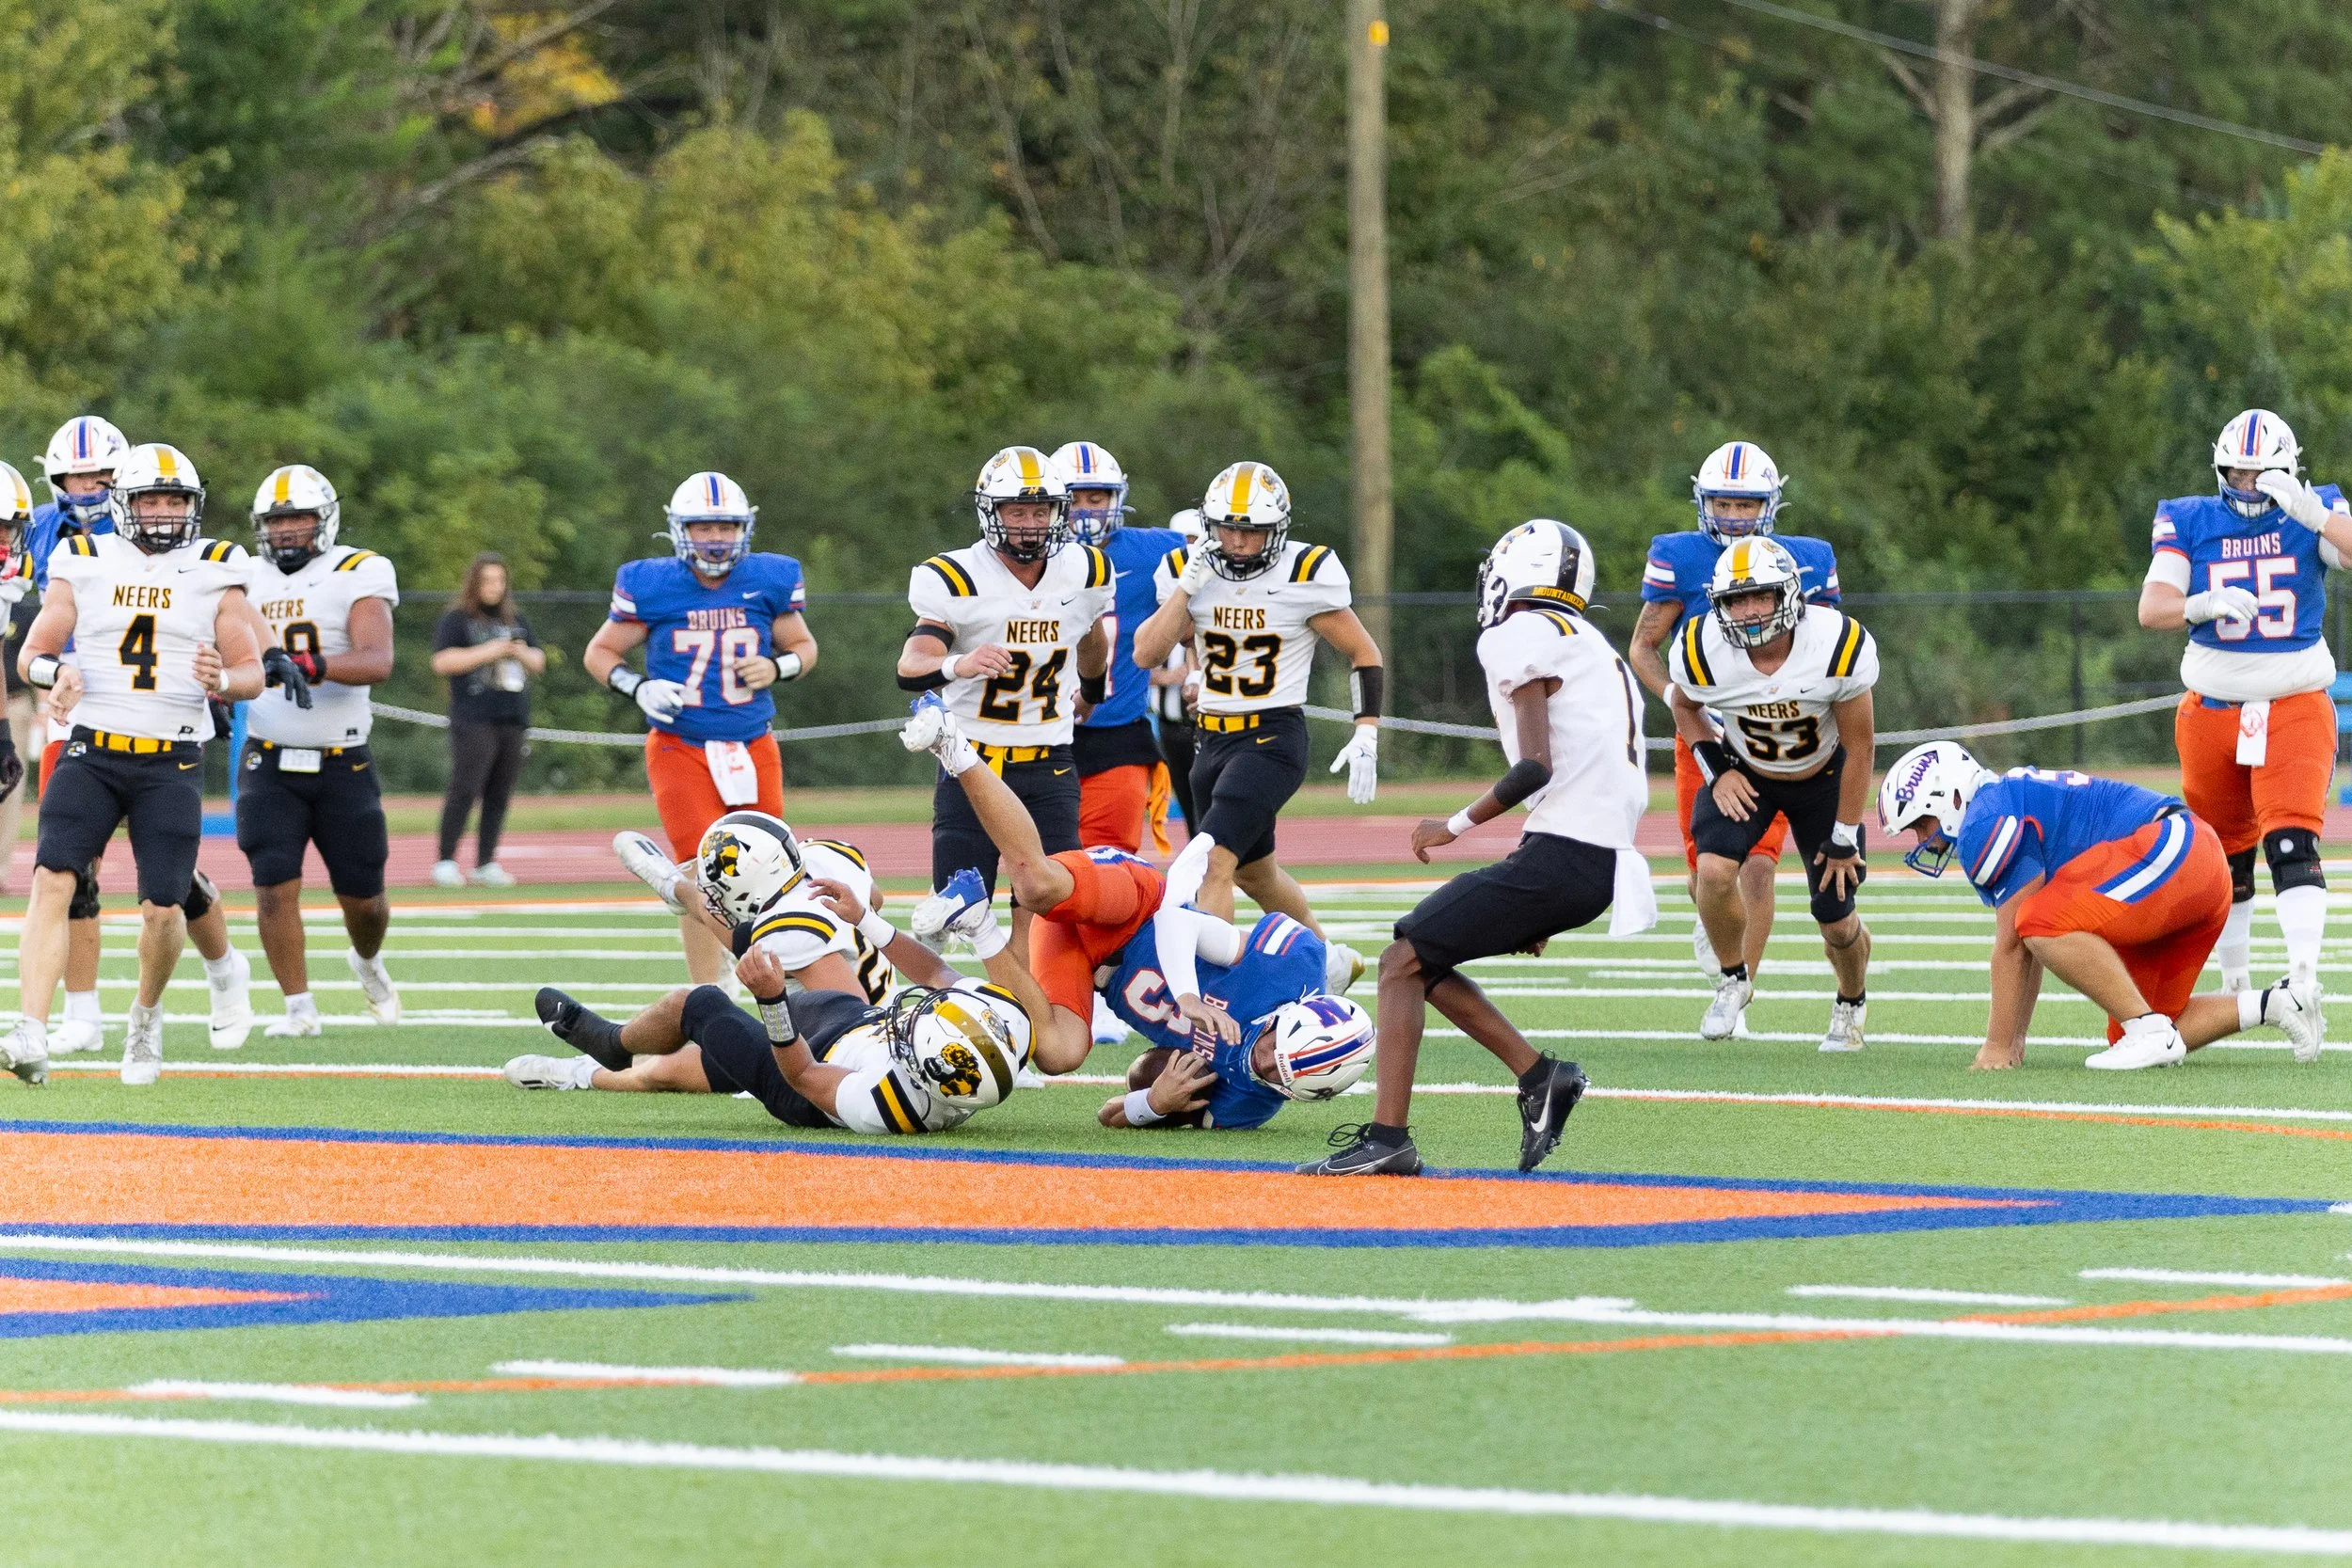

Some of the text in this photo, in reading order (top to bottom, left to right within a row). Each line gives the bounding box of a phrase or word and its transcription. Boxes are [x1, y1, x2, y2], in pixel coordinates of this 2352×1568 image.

[2221, 531, 2282, 560] BRUINS
[113, 584, 172, 610] NEERS
[261, 597, 306, 620] NEERS
[2207, 555, 2297, 642] 55
[687, 607, 747, 630] BRUINS
[1006, 619, 1060, 644] NEERS
[1213, 606, 1266, 630] NEERS
[119, 613, 159, 693] 4
[673, 626, 760, 707] 70
[1203, 630, 1283, 699] 23
[977, 646, 1070, 724] 24
[1614, 656, 1640, 769] 1
[1747, 700, 1801, 720] NEERS
[1737, 714, 1820, 763] 53
[1191, 992, 1230, 1063] BINS
[1302, 997, 1353, 1029] N
[1278, 1053, 1293, 1084] Riddell
